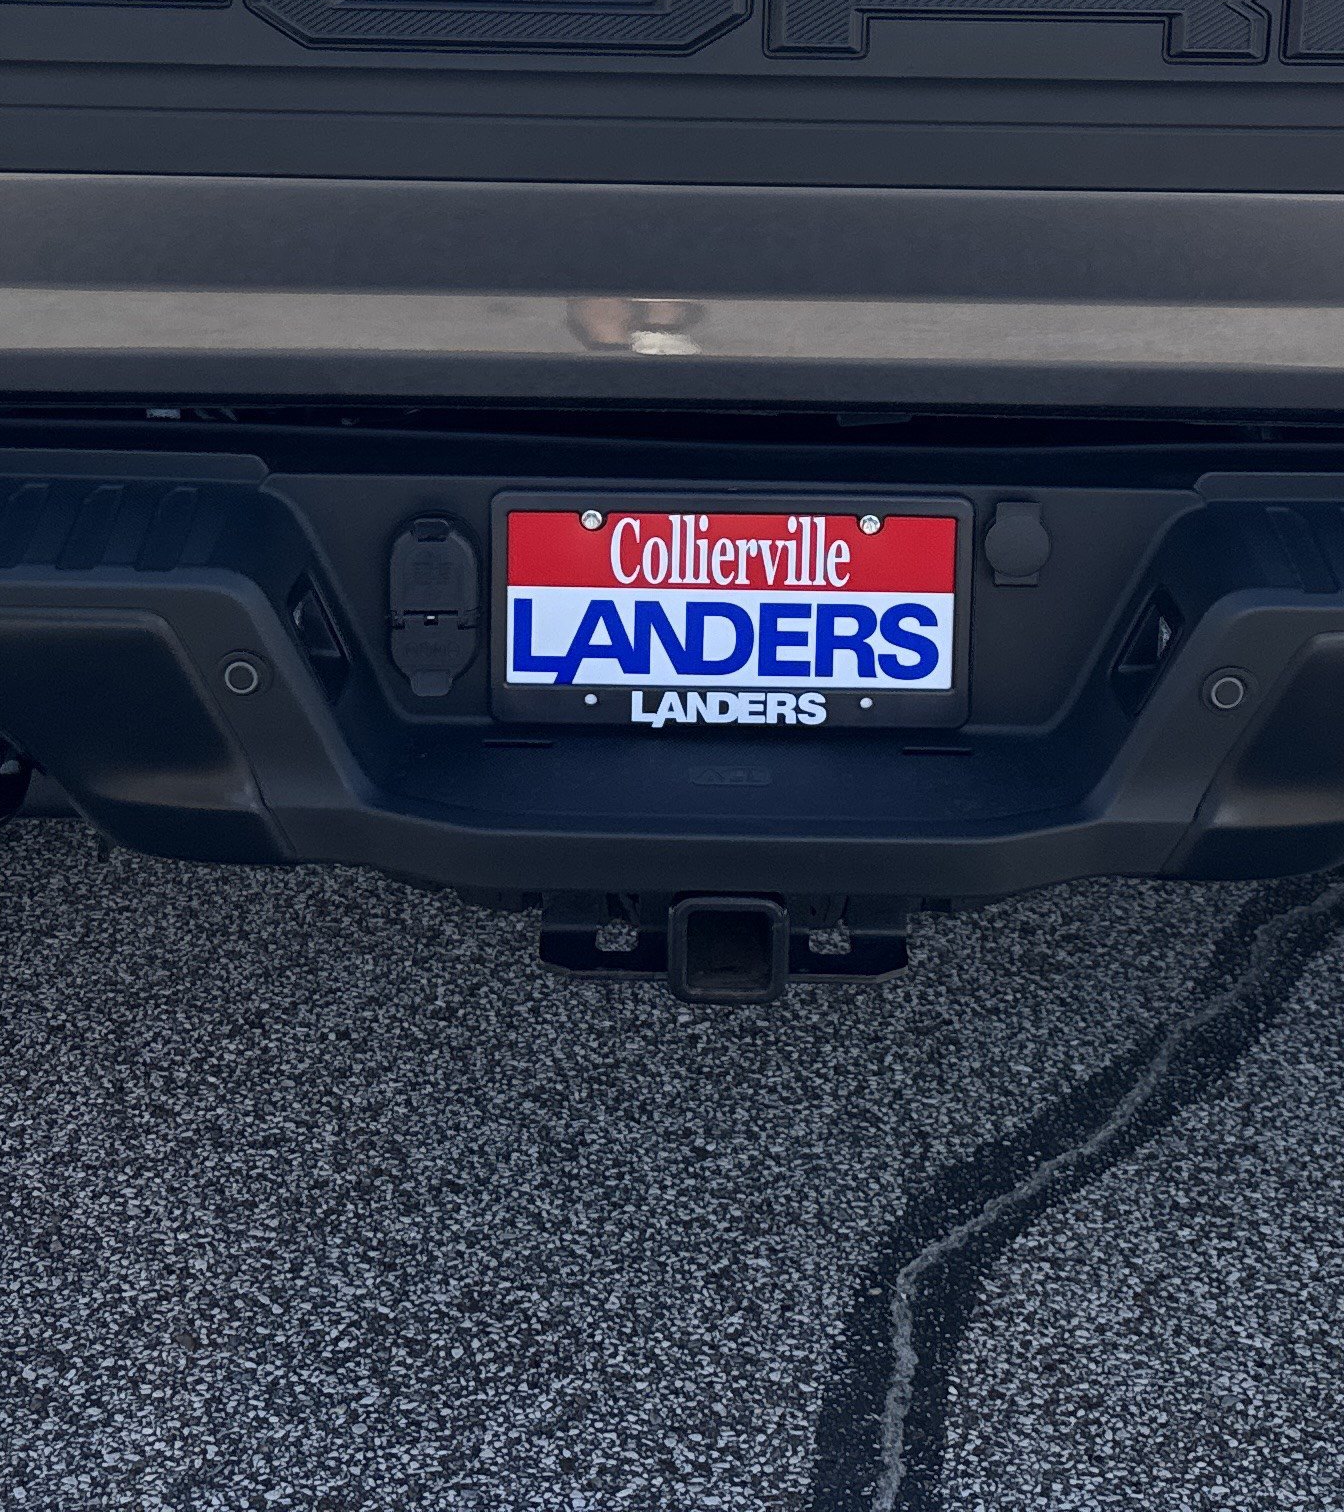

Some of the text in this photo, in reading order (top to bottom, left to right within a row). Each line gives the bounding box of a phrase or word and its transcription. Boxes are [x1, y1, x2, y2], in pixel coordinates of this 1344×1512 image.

[608, 514, 852, 589] Collierville
[510, 597, 941, 685] LANDERS
[630, 689, 827, 728] LANDERS
